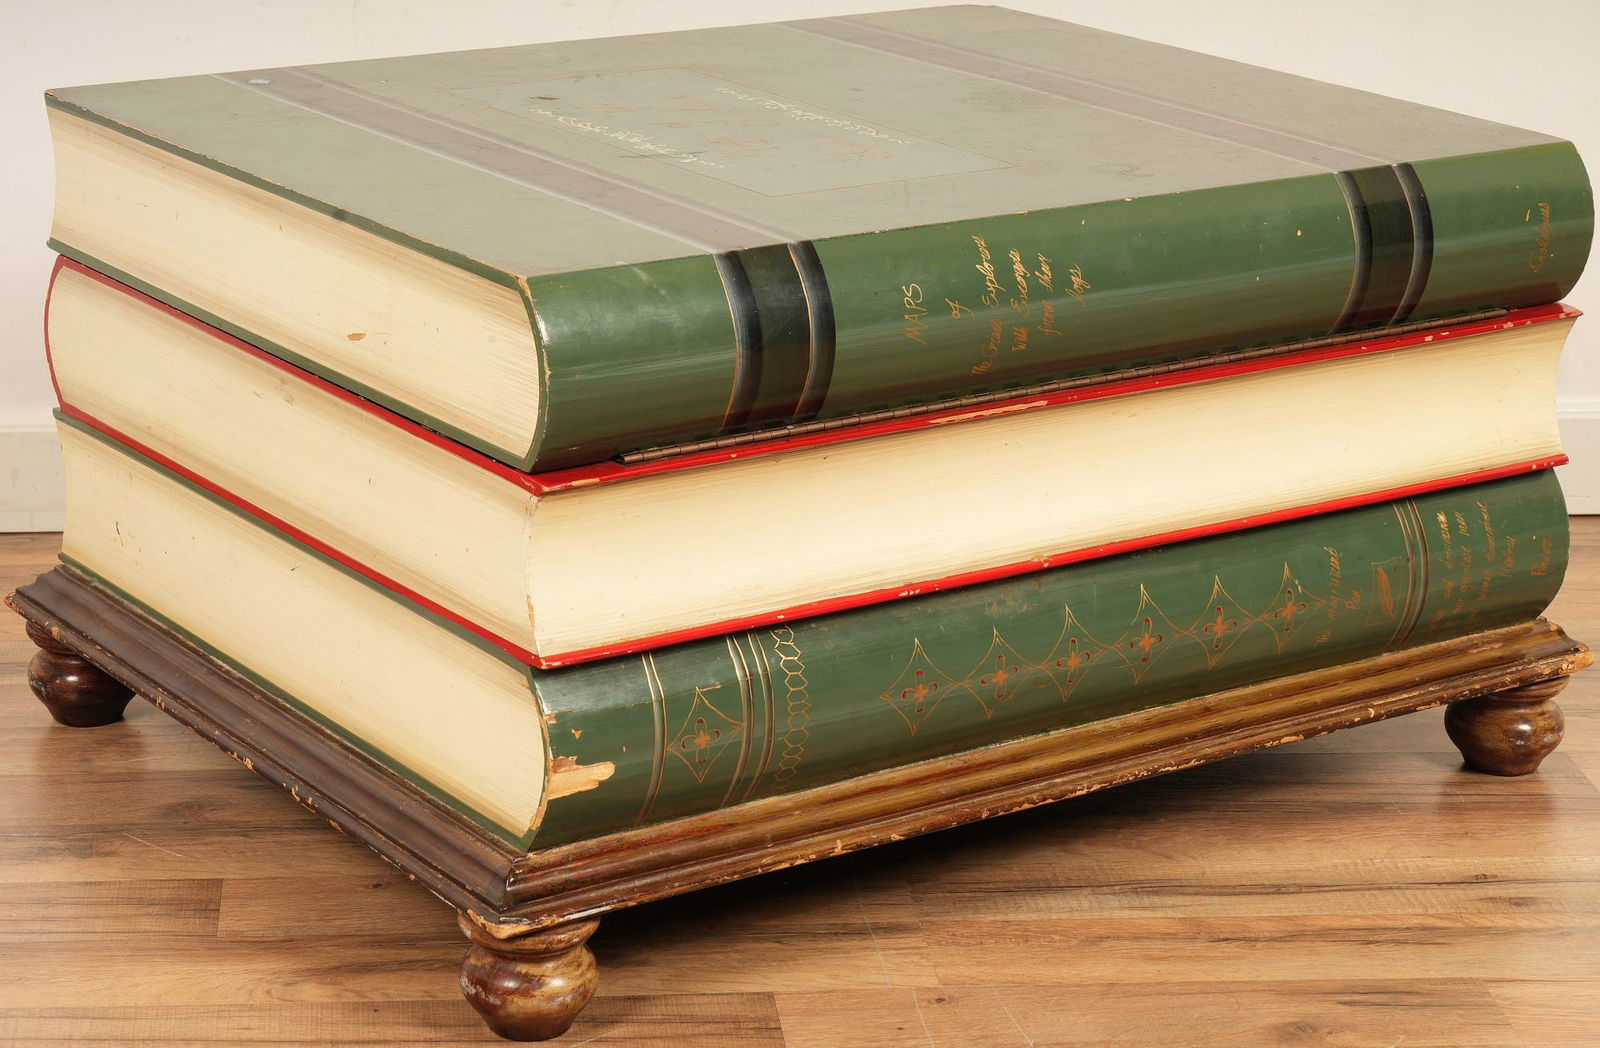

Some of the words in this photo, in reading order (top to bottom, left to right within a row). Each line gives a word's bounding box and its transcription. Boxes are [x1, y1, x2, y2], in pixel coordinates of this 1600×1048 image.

[1064, 263, 1091, 307] logs
[901, 283, 929, 346] MAPS
[945, 298, 976, 320] of
